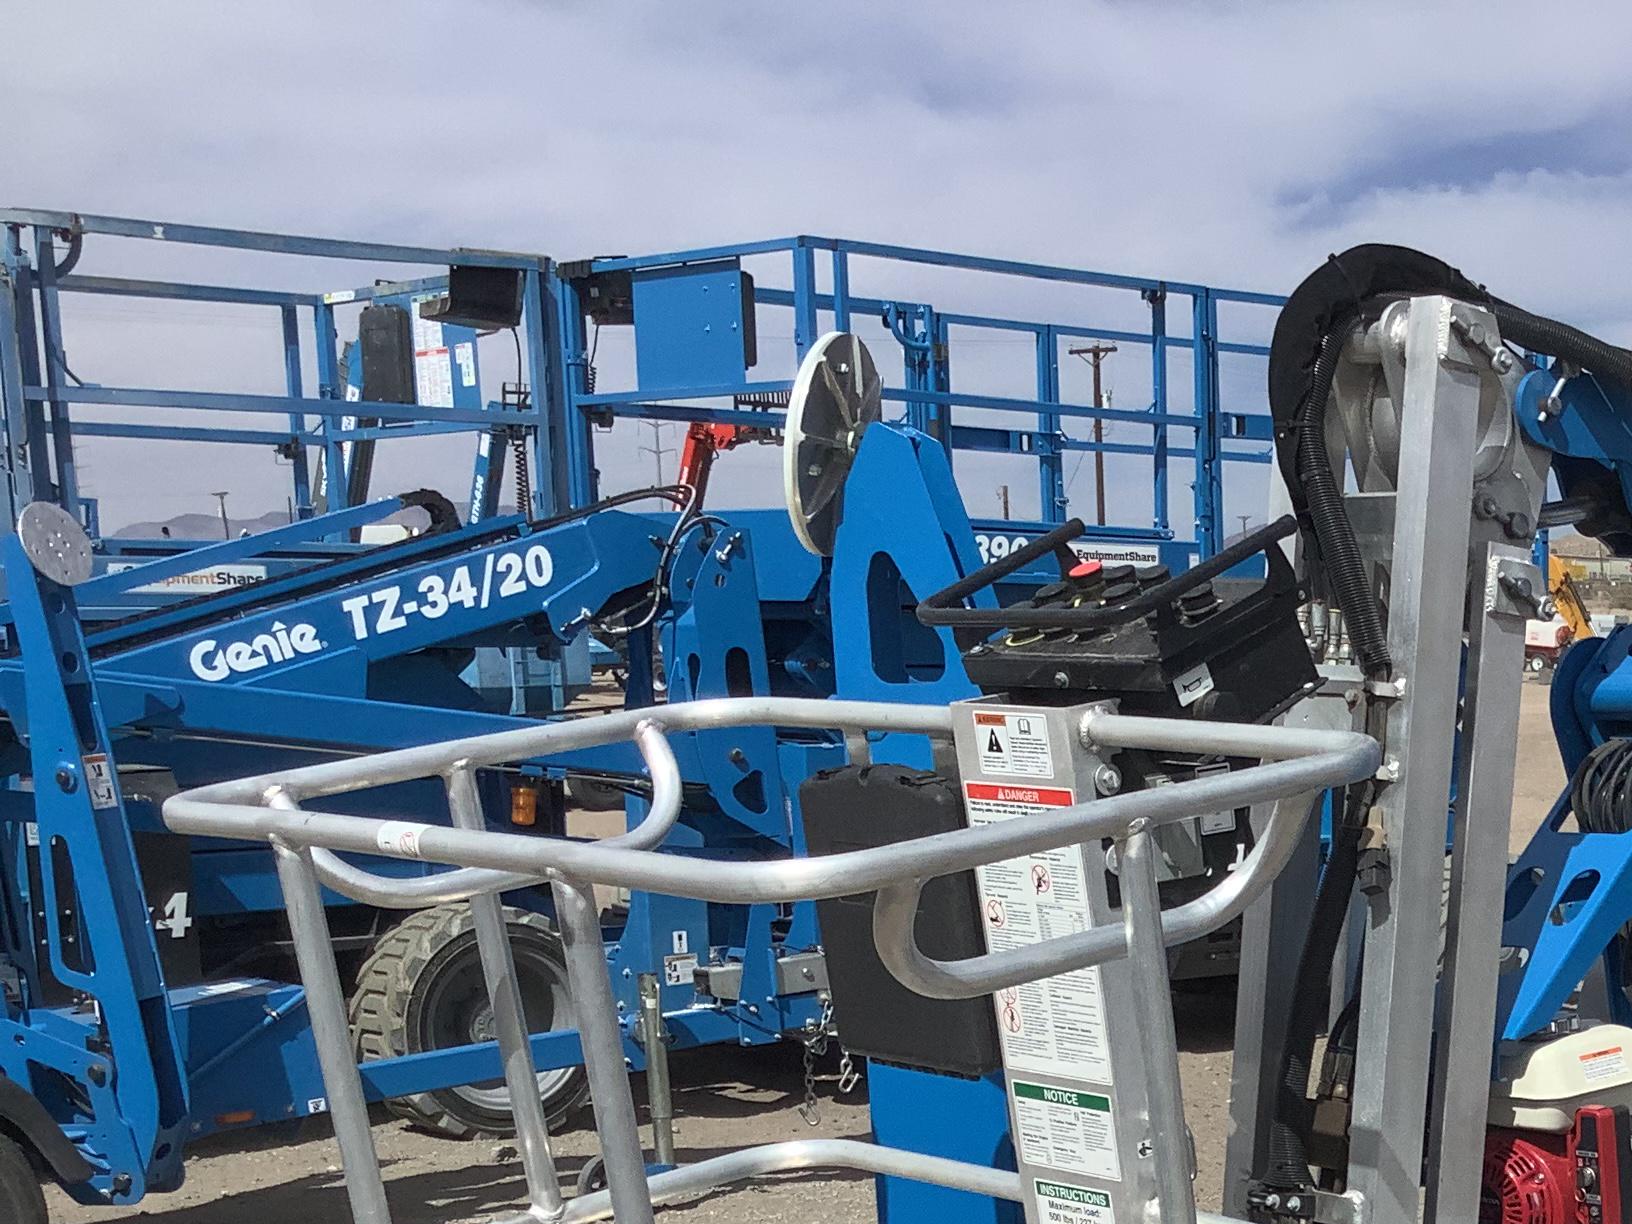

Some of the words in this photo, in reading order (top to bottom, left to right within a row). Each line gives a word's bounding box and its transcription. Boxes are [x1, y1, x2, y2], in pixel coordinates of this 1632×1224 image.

[1077, 549, 1157, 562] EquipmentShare
[160, 572, 264, 587] pmentShare
[189, 621, 323, 682] Genie
[342, 545, 553, 640] TZ-34/20
[1005, 788, 1039, 803] DANGER
[1044, 1088, 1078, 1106] NOTICE
[1040, 1184, 1107, 1207] INSTRUCTIONS
[1048, 1200, 1083, 1214] Maximum
